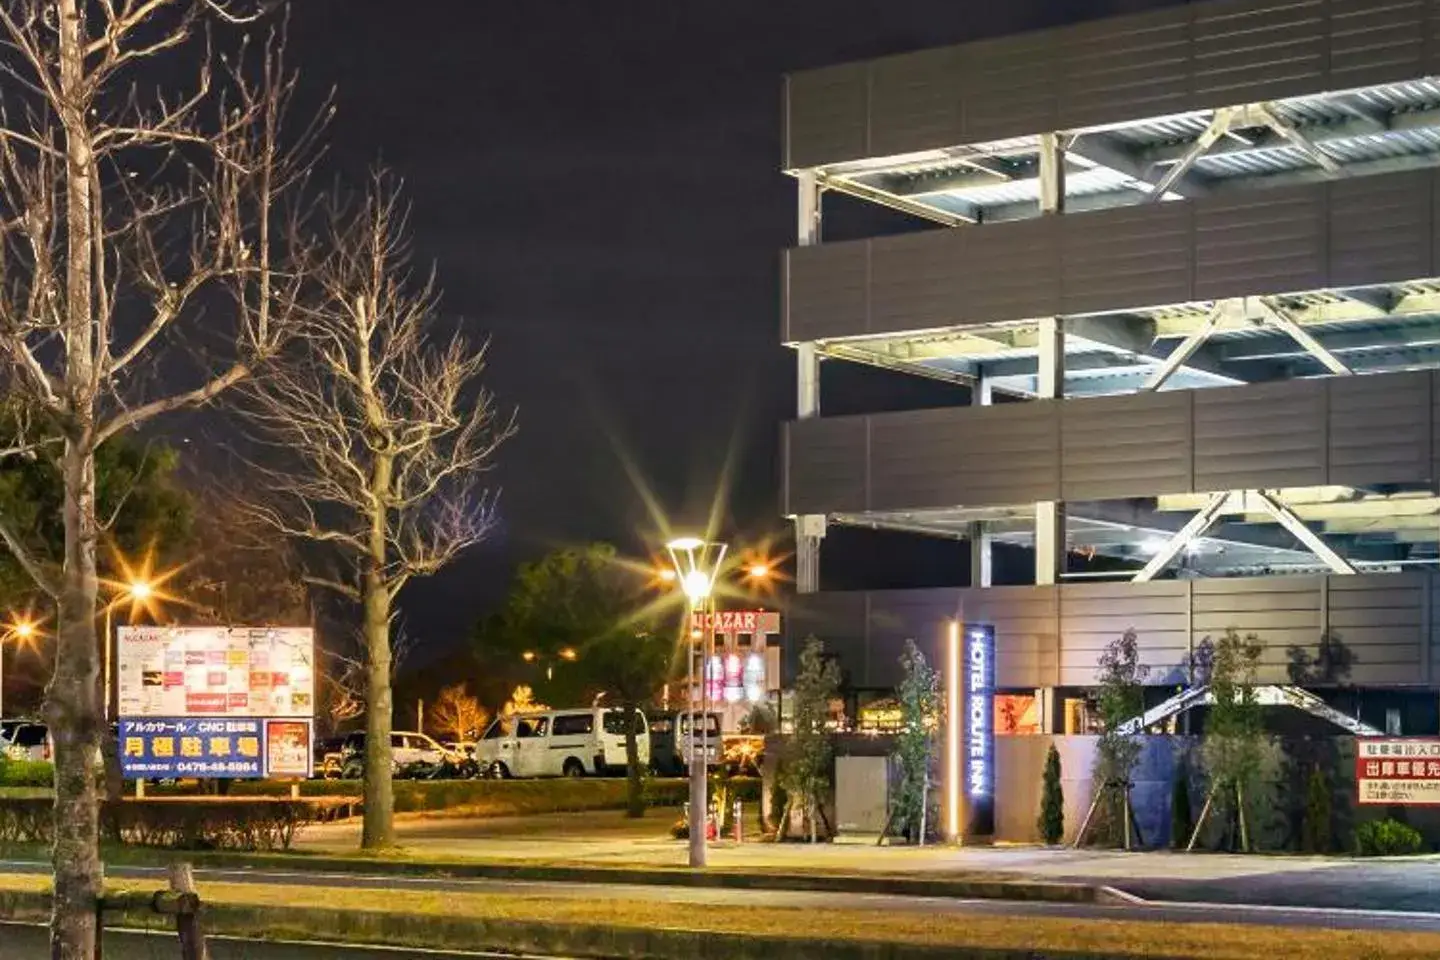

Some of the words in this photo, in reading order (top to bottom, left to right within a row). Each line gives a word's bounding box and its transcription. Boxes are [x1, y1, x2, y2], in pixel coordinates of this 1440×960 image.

[971, 632, 985, 692] HOTEL
[971, 695, 985, 757] ROUTE
[1366, 744, 1440, 755] 駐車場出入口
[971, 760, 985, 795] INN
[1366, 760, 1440, 776] 出庫車優先
